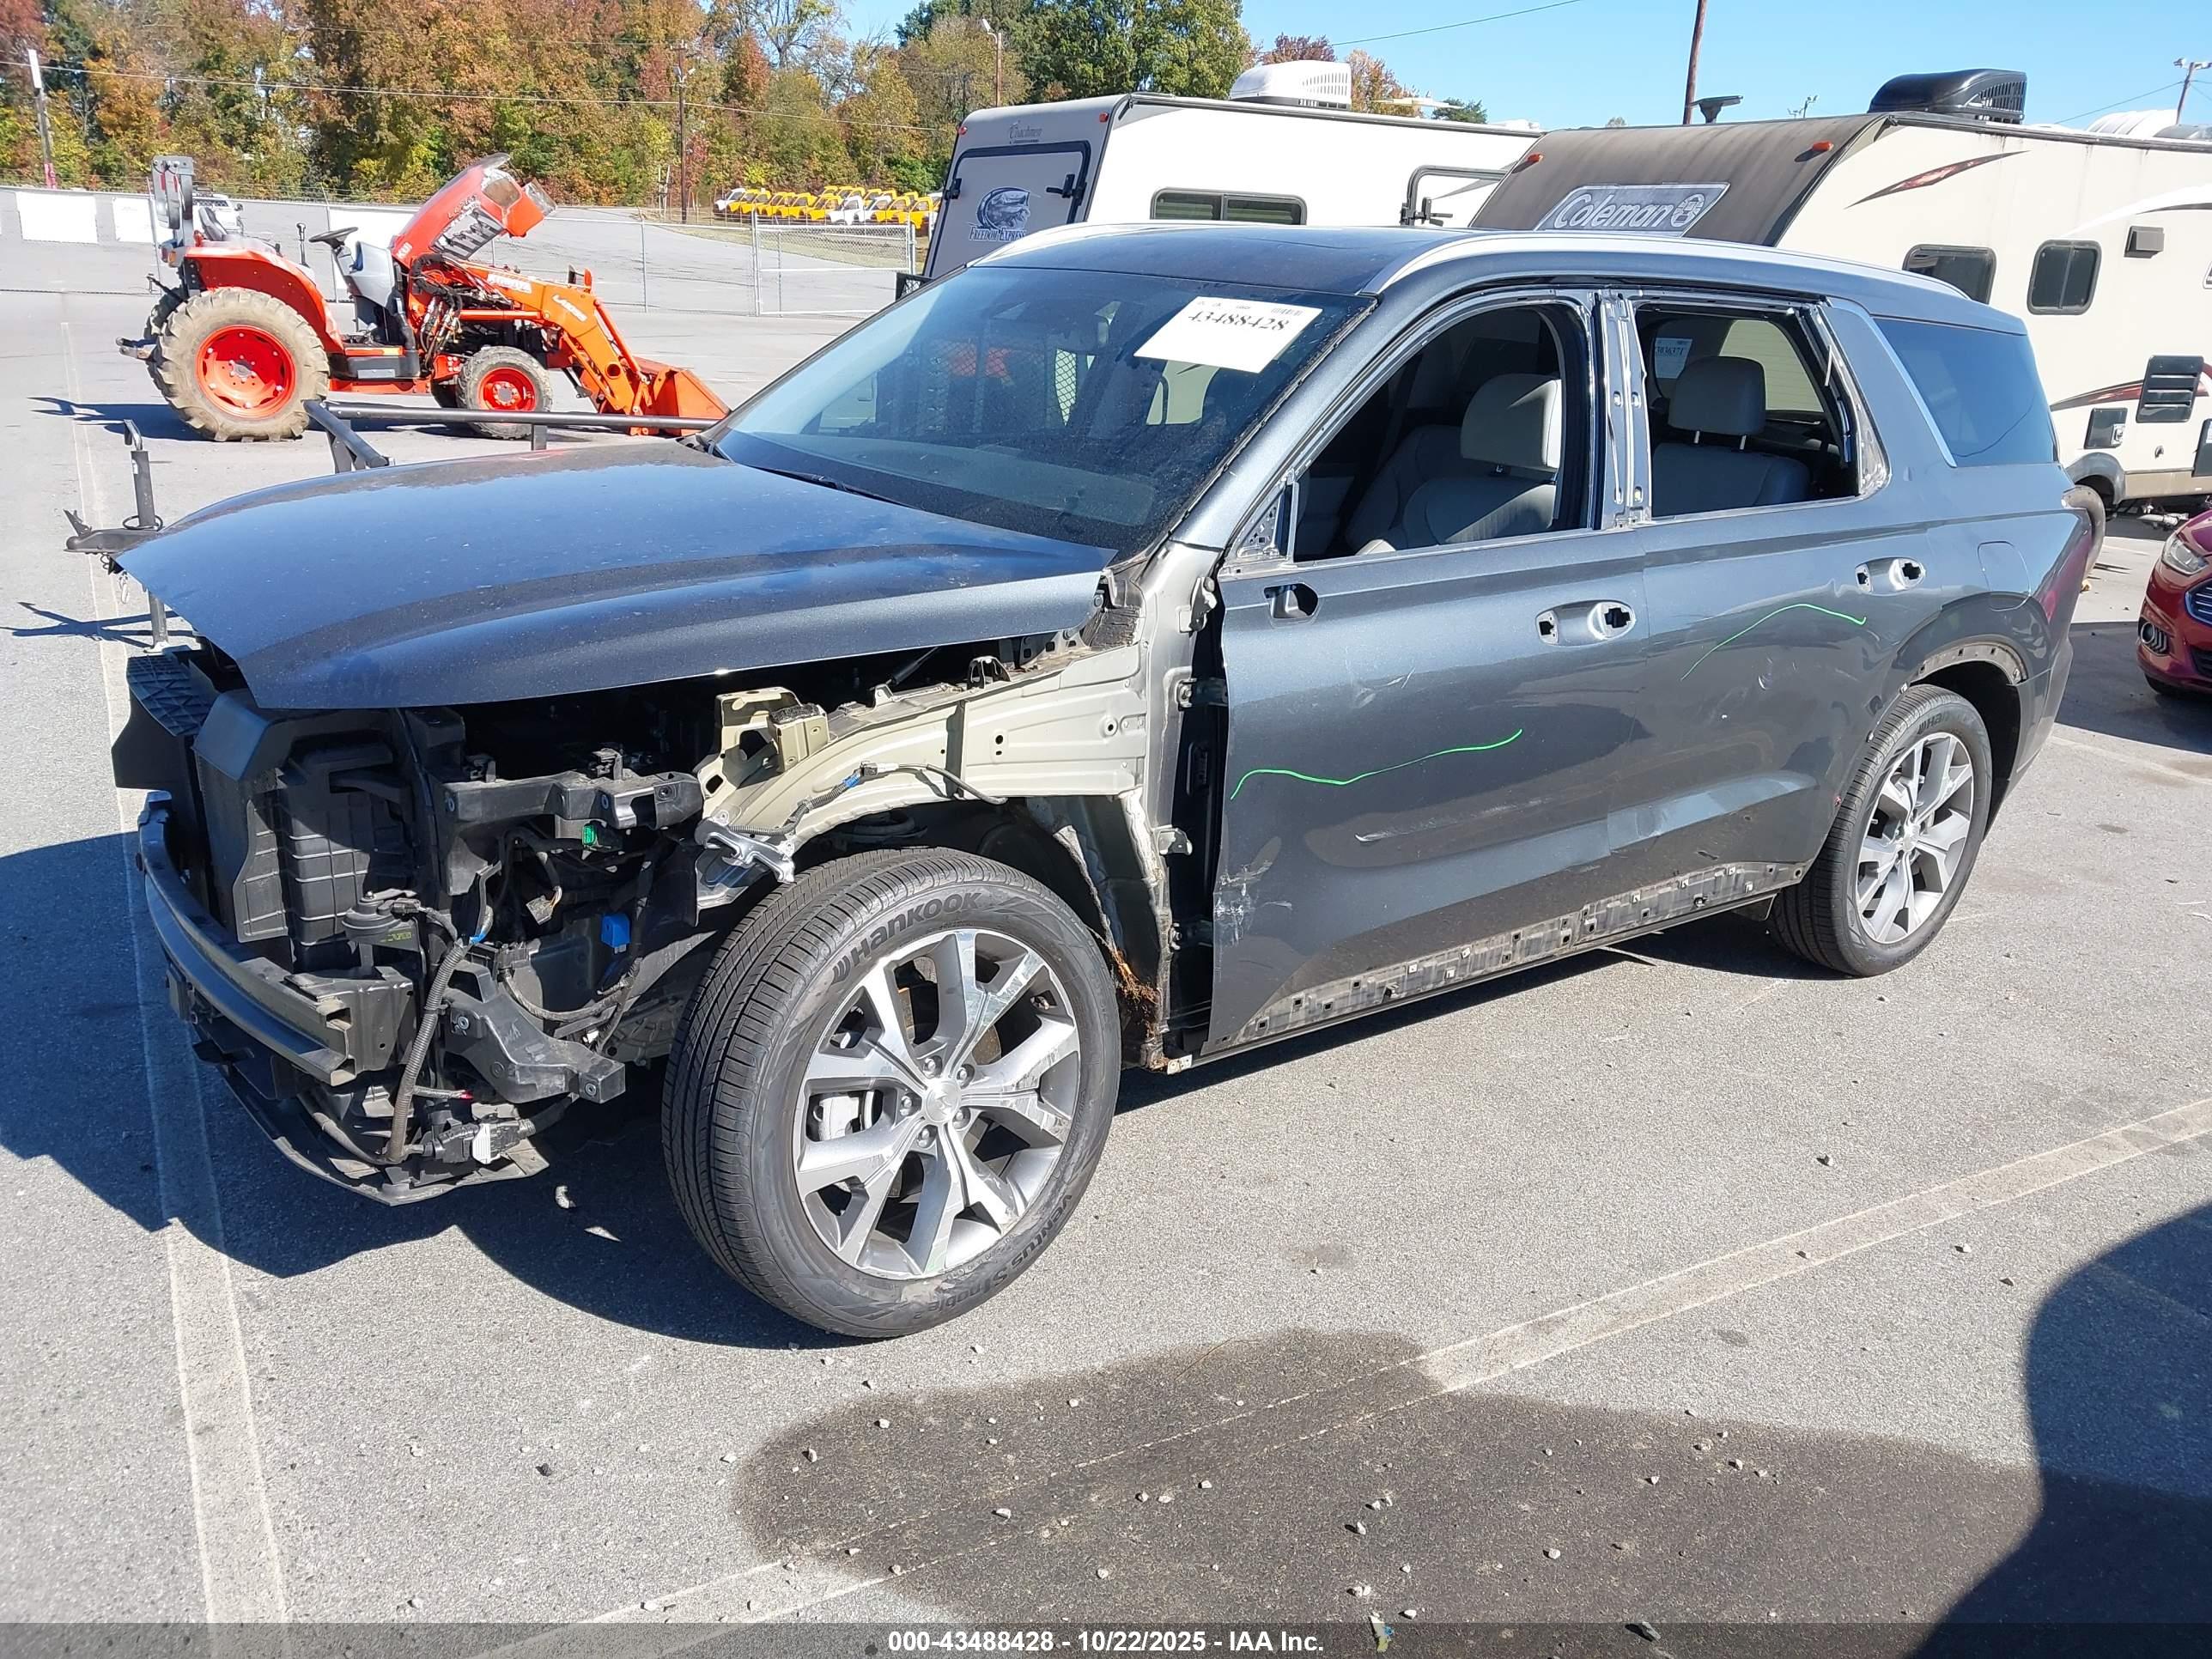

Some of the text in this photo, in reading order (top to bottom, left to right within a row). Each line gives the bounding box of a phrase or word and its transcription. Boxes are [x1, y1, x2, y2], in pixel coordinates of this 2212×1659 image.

[1554, 193, 1674, 228] Coleman
[969, 226, 1000, 241] FREEDOM
[1188, 310, 1289, 331] 43488428
